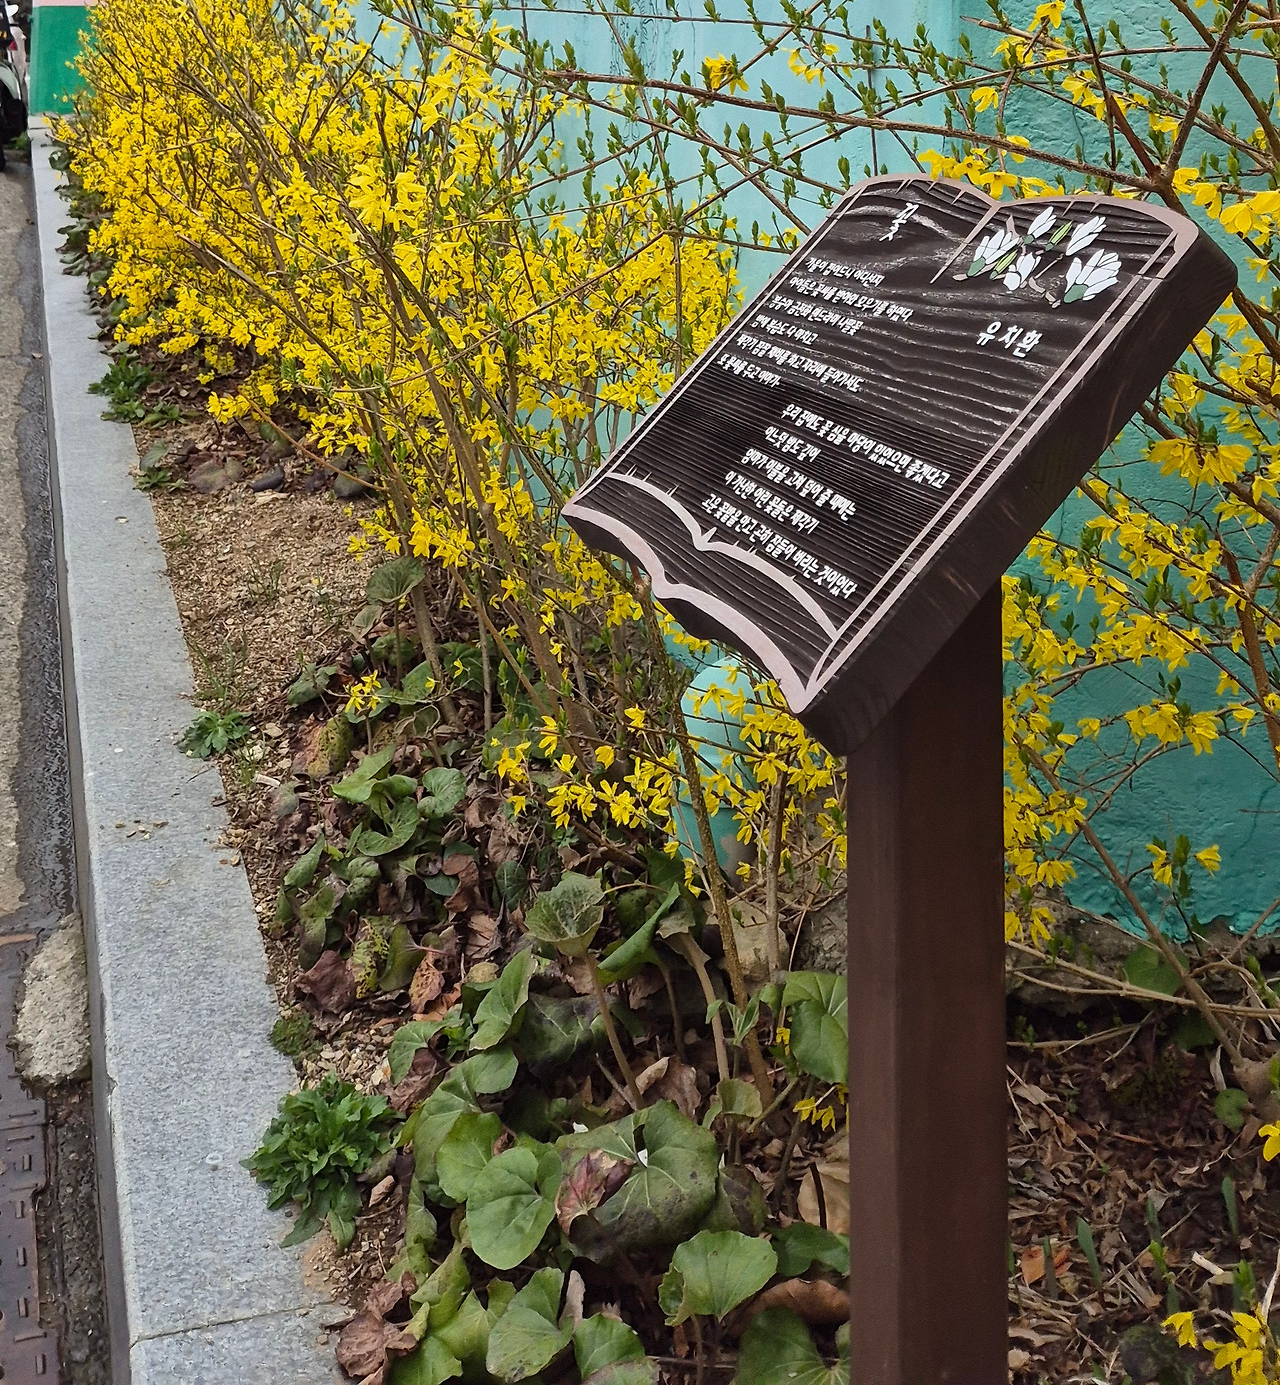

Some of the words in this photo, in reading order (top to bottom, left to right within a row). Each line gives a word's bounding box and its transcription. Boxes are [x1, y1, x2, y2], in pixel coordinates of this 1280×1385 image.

[878, 202, 920, 242] 꽃
[768, 294, 795, 311] 봉숭아
[807, 306, 842, 327] 맨드라미
[837, 316, 864, 336] 나팔꽃
[789, 276, 817, 295] 아이들은
[853, 295, 890, 318] 모우기를
[885, 303, 914, 322] 하였다
[751, 314, 772, 328] 밤에
[765, 318, 790, 335] 복습도
[786, 325, 798, 338] 다
[793, 328, 819, 345] 마치고
[976, 321, 1043, 358] 유치환
[716, 353, 731, 366] 또
[722, 356, 749, 375] 꽃씨를
[736, 333, 759, 351] 제각기
[751, 340, 772, 358] 잠잘
[767, 345, 792, 366] 채비를
[785, 353, 808, 369] 하고
[801, 358, 829, 378] 자리에
[819, 366, 865, 393] 들어가서도
[742, 363, 762, 379] 두고
[764, 426, 790, 449] 어느덧
[781, 435, 805, 455] 밤도
[796, 443, 822, 463] 깊어
[781, 403, 803, 421] 우리
[794, 409, 825, 431] 집에도
[816, 419, 835, 438] 꽃
[826, 424, 850, 446] 심을
[846, 432, 877, 455] 마당이
[868, 443, 913, 474] 있었으면
[904, 459, 951, 489] 좋겠다고
[724, 470, 738, 486] 이
[731, 474, 758, 500] 가난한
[753, 487, 773, 509] 어린
[763, 495, 795, 522] 꽃들은
[790, 509, 820, 535] 제각기
[740, 448, 770, 469] 엄마가
[765, 459, 791, 484] 이불을
[783, 470, 808, 491] 고쳐
[798, 479, 825, 500] 덮어
[815, 488, 834, 507] 줄
[829, 493, 857, 521] 때에는
[701, 493, 722, 514] 고운
[713, 501, 743, 528] 꽃밭을
[734, 514, 759, 535] 안고
[748, 524, 774, 545] 곤히
[765, 534, 798, 561] 잠들어
[792, 549, 820, 579] 버리는
[813, 565, 858, 599] 것이었다
